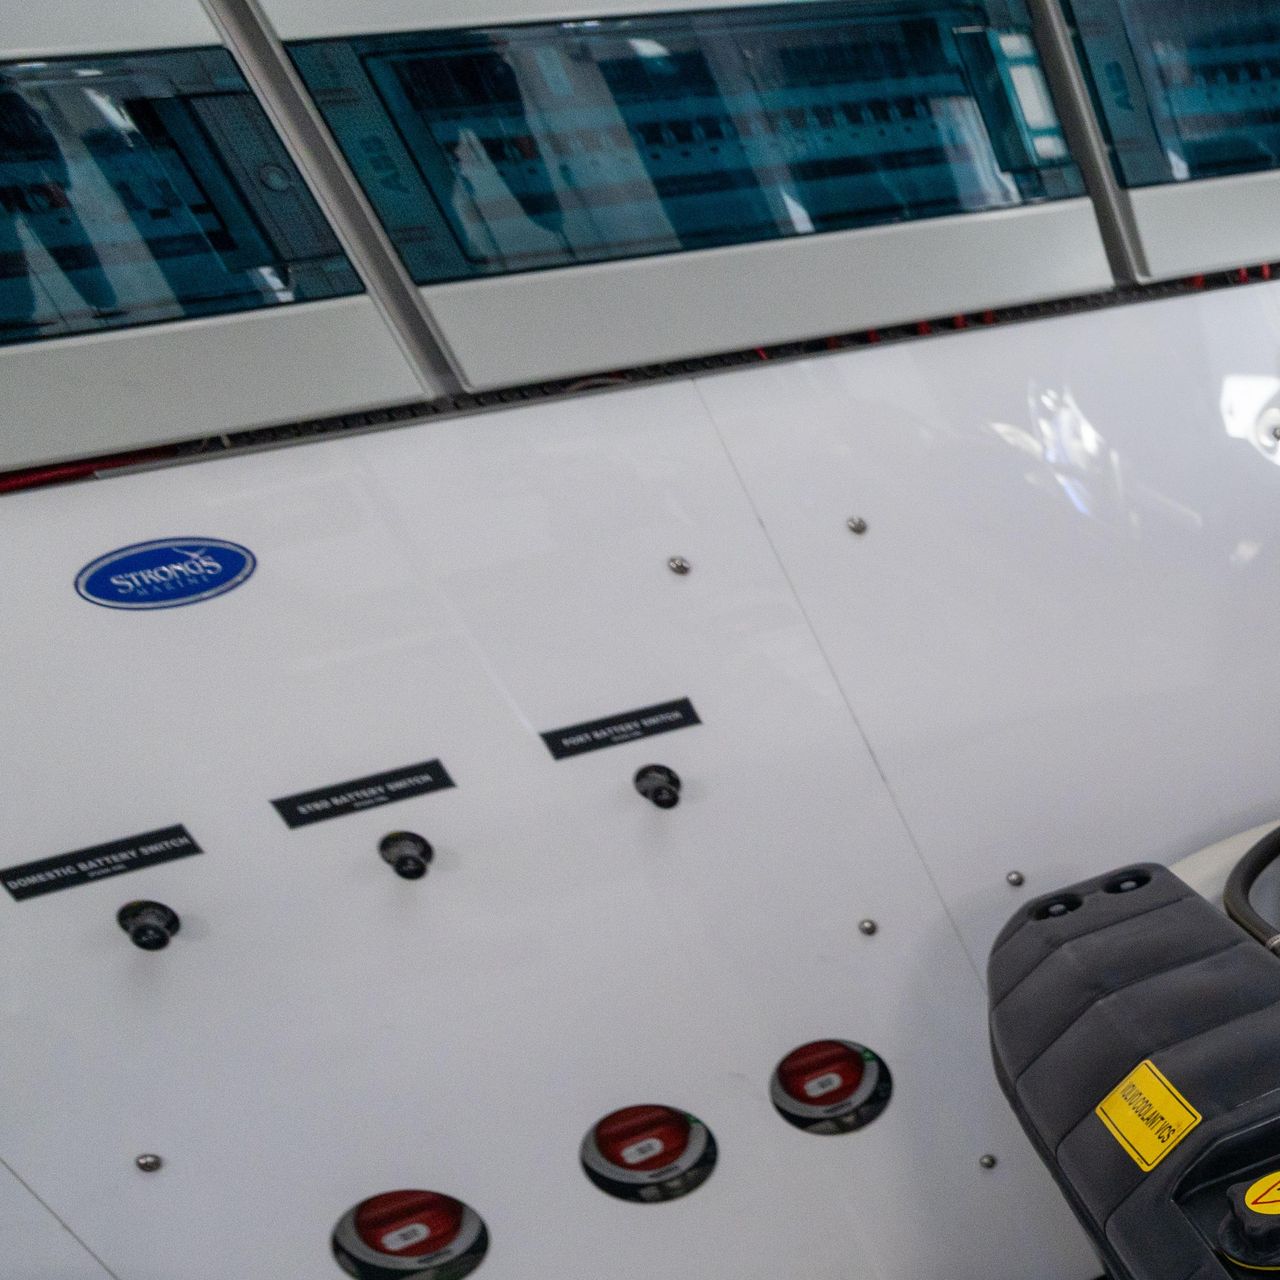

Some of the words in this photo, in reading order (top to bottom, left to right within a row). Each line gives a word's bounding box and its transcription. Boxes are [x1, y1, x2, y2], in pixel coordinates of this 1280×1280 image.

[641, 710, 683, 727] SWITCH
[329, 785, 385, 806] BATTERY
[385, 773, 434, 792] SWITCH
[6, 863, 79, 890] DOMESTIC
[75, 850, 140, 872] BATTERY
[139, 835, 192, 856] SWITCH
[1132, 1097, 1164, 1131] COOLANT
[1154, 1121, 1176, 1144] VCS
